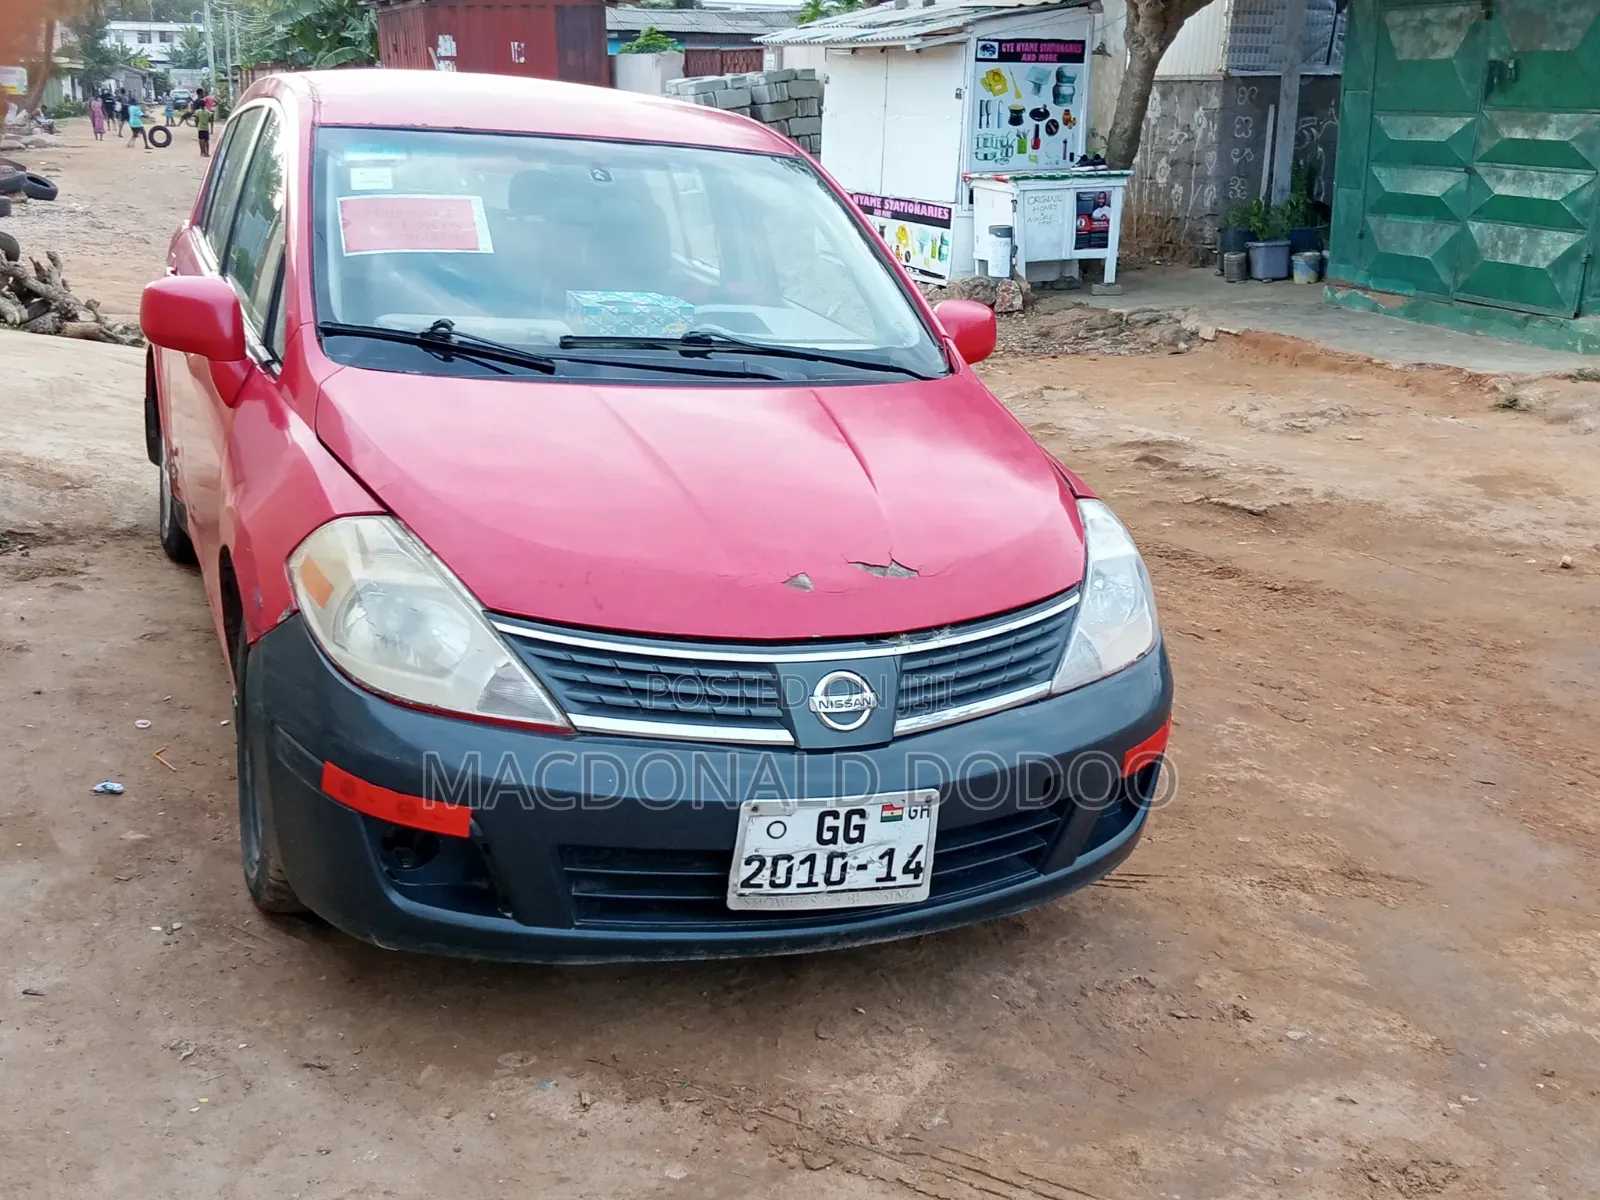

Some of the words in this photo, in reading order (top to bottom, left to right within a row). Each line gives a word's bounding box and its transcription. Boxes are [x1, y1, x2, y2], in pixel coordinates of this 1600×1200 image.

[1016, 43, 1038, 53] NYAME
[1021, 53, 1036, 61] AND
[1038, 53, 1058, 61] MORE
[883, 199, 950, 220] STATIONARIES
[818, 696, 872, 710] NISSAN
[908, 804, 930, 820] GH
[816, 808, 867, 846] GG
[740, 844, 924, 889] 2010-14
